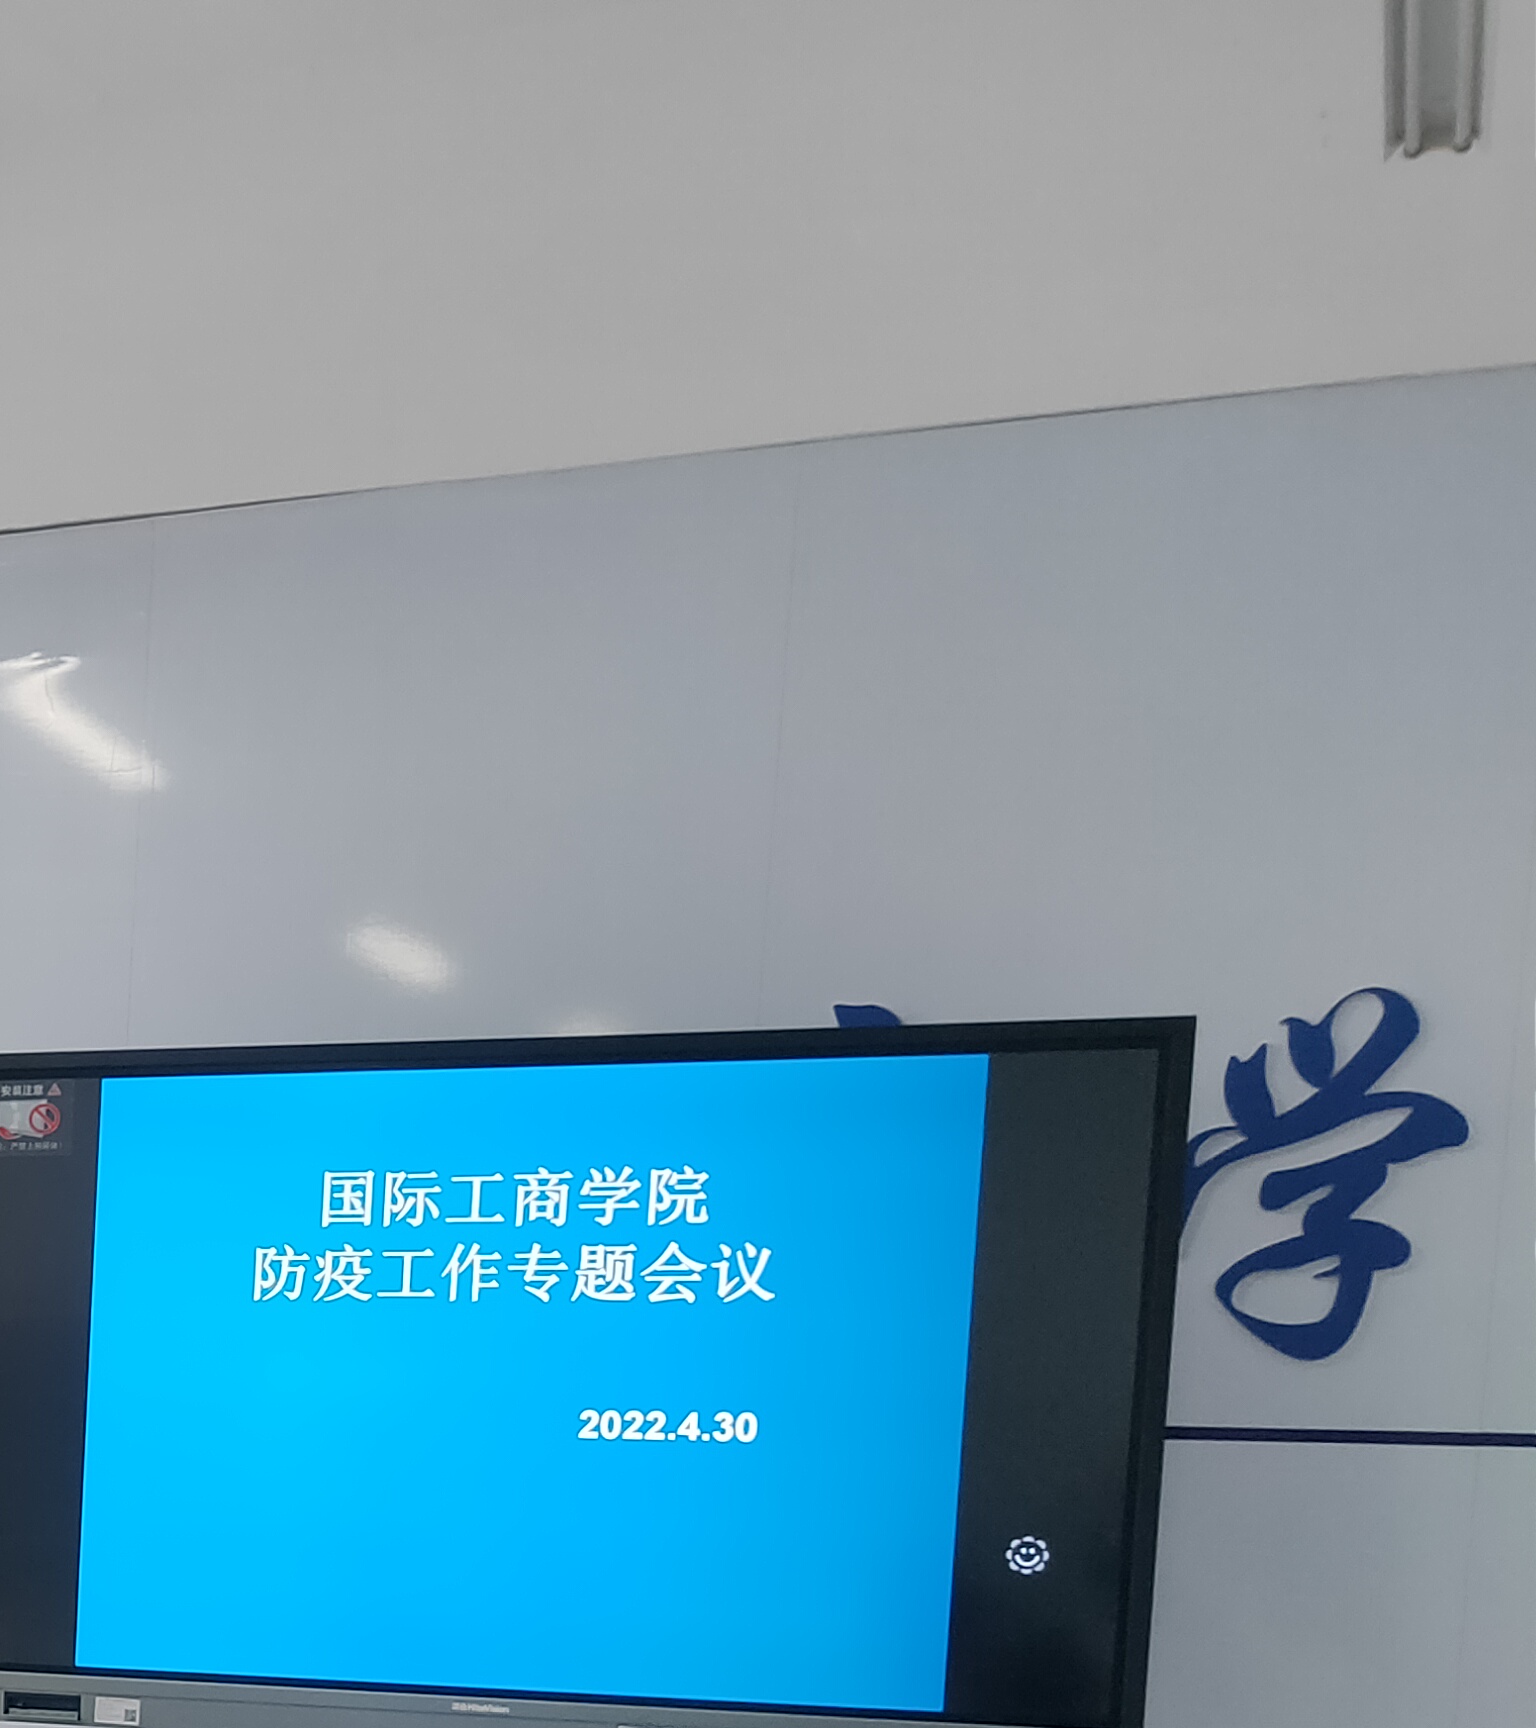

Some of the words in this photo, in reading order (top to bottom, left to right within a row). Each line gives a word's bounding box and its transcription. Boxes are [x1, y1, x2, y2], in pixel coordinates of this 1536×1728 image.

[319, 1164, 710, 1229] 国际工商学院
[251, 1240, 777, 1305] 防疫工作专题会议
[577, 1408, 759, 1443] 2022.4.30
